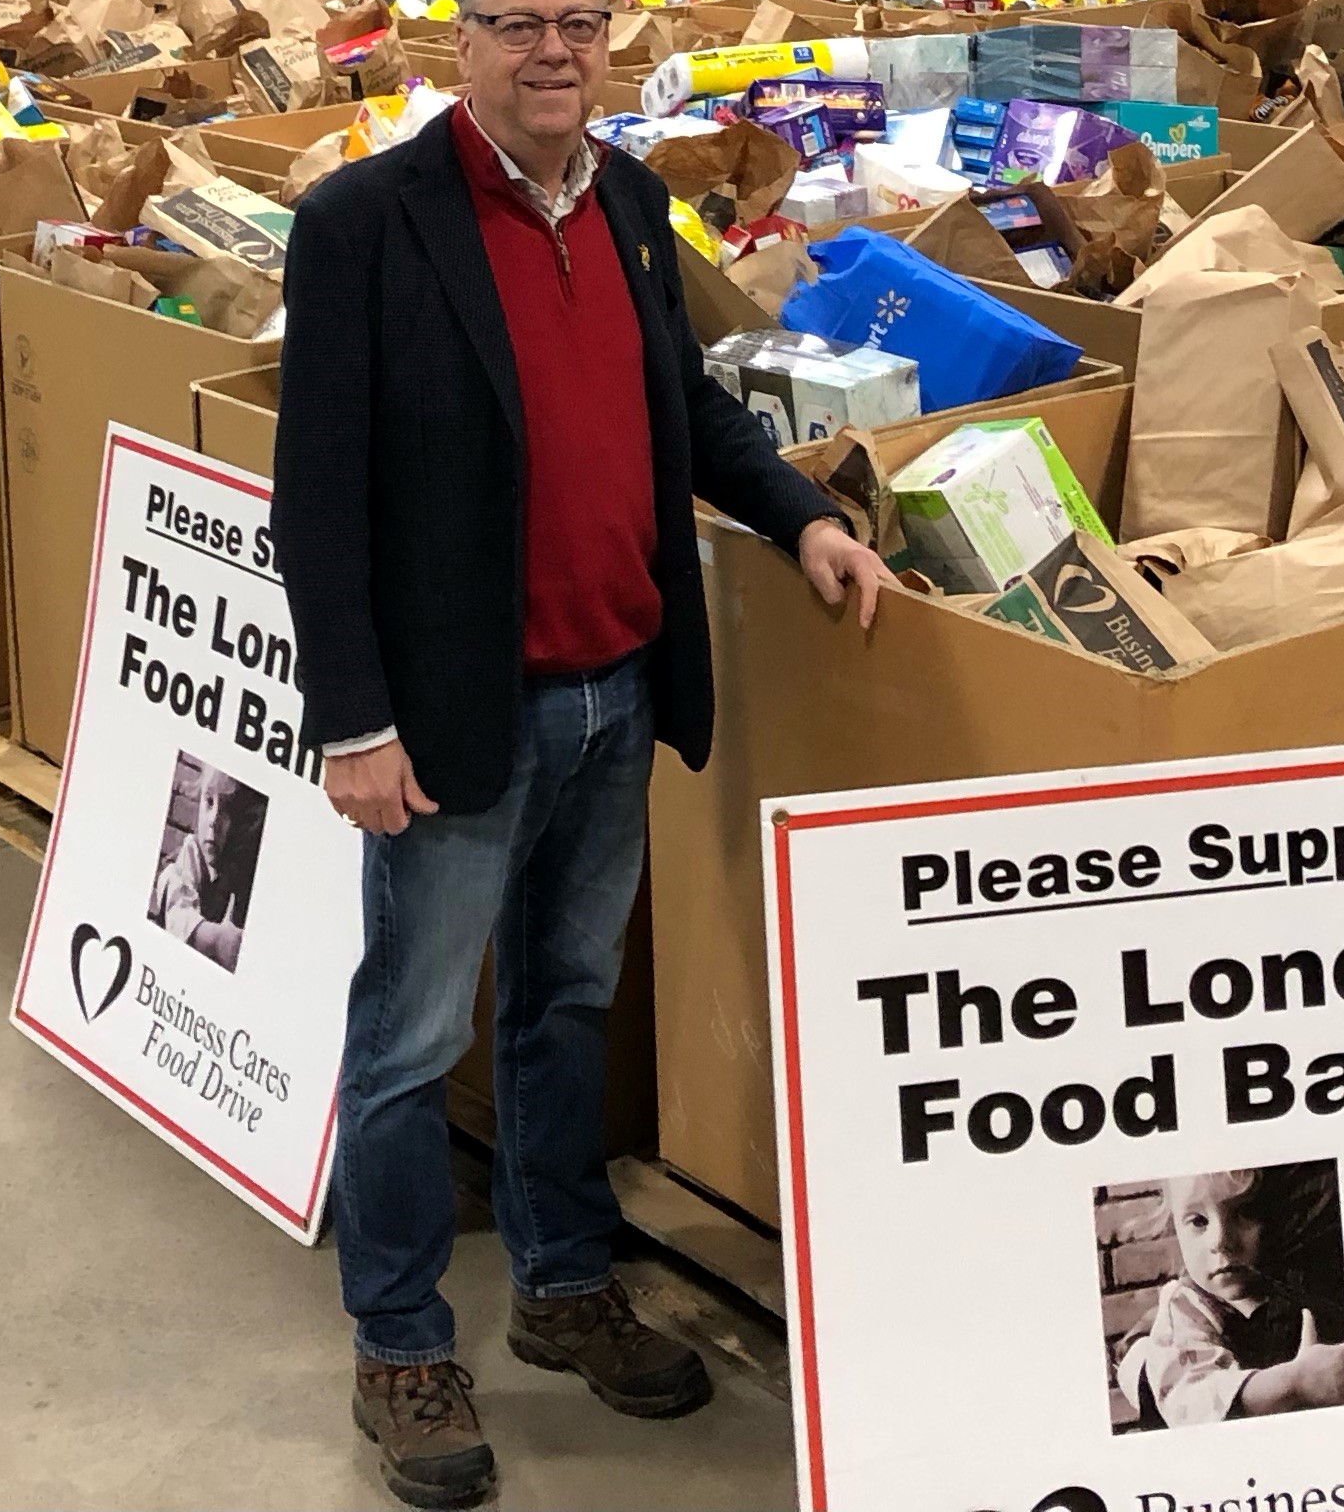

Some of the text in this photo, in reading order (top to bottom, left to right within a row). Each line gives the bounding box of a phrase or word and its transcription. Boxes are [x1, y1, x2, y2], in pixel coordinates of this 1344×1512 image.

[795, 47, 810, 58] 12
[1140, 131, 1202, 160] Pampers
[145, 484, 243, 556] Please
[122, 555, 293, 684] The Lon
[118, 633, 323, 786] Food Ban
[901, 843, 1162, 911] Please
[135, 964, 291, 1102] Business Cares
[857, 970, 1078, 1056] The
[142, 1020, 263, 1133] Food Drive
[898, 1055, 1179, 1164] Food
